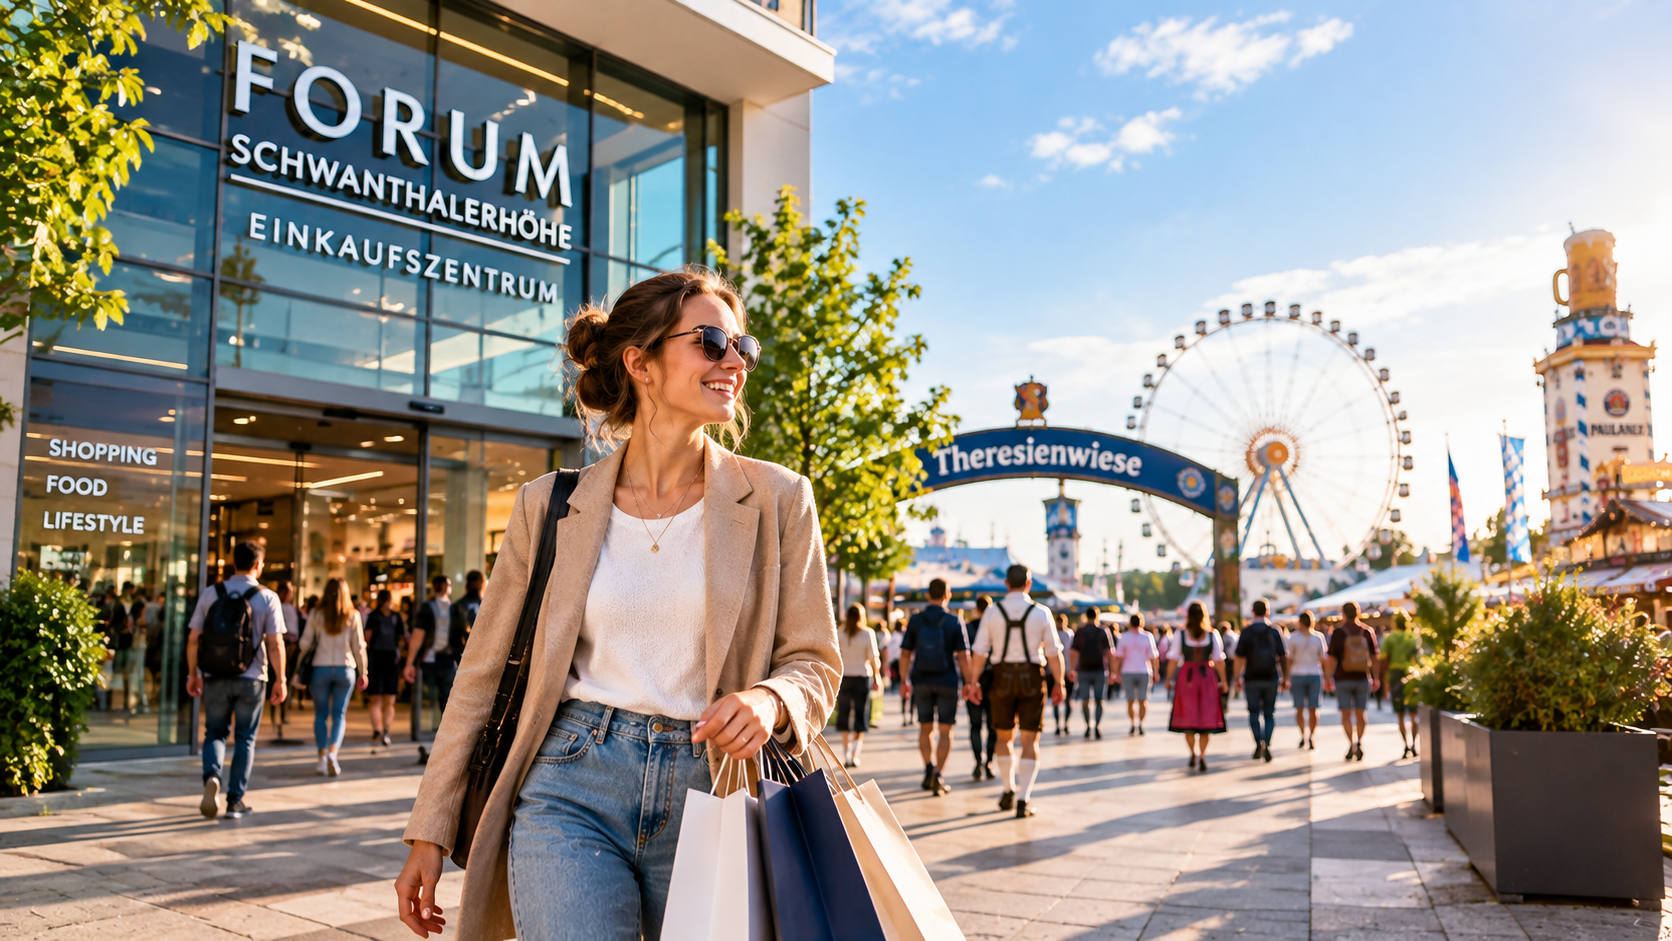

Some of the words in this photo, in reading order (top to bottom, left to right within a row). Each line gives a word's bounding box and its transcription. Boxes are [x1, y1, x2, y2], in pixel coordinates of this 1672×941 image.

[234, 39, 574, 208] FORUM
[230, 133, 573, 250] SCHWANTHALERHÖHE
[249, 212, 558, 304] EINKAUFSZENTRUM
[48, 438, 158, 466] SHOPPING
[933, 436, 1143, 477] Theresienwiese
[46, 474, 108, 497] FOOD
[43, 510, 145, 535] LIFESTYLE
